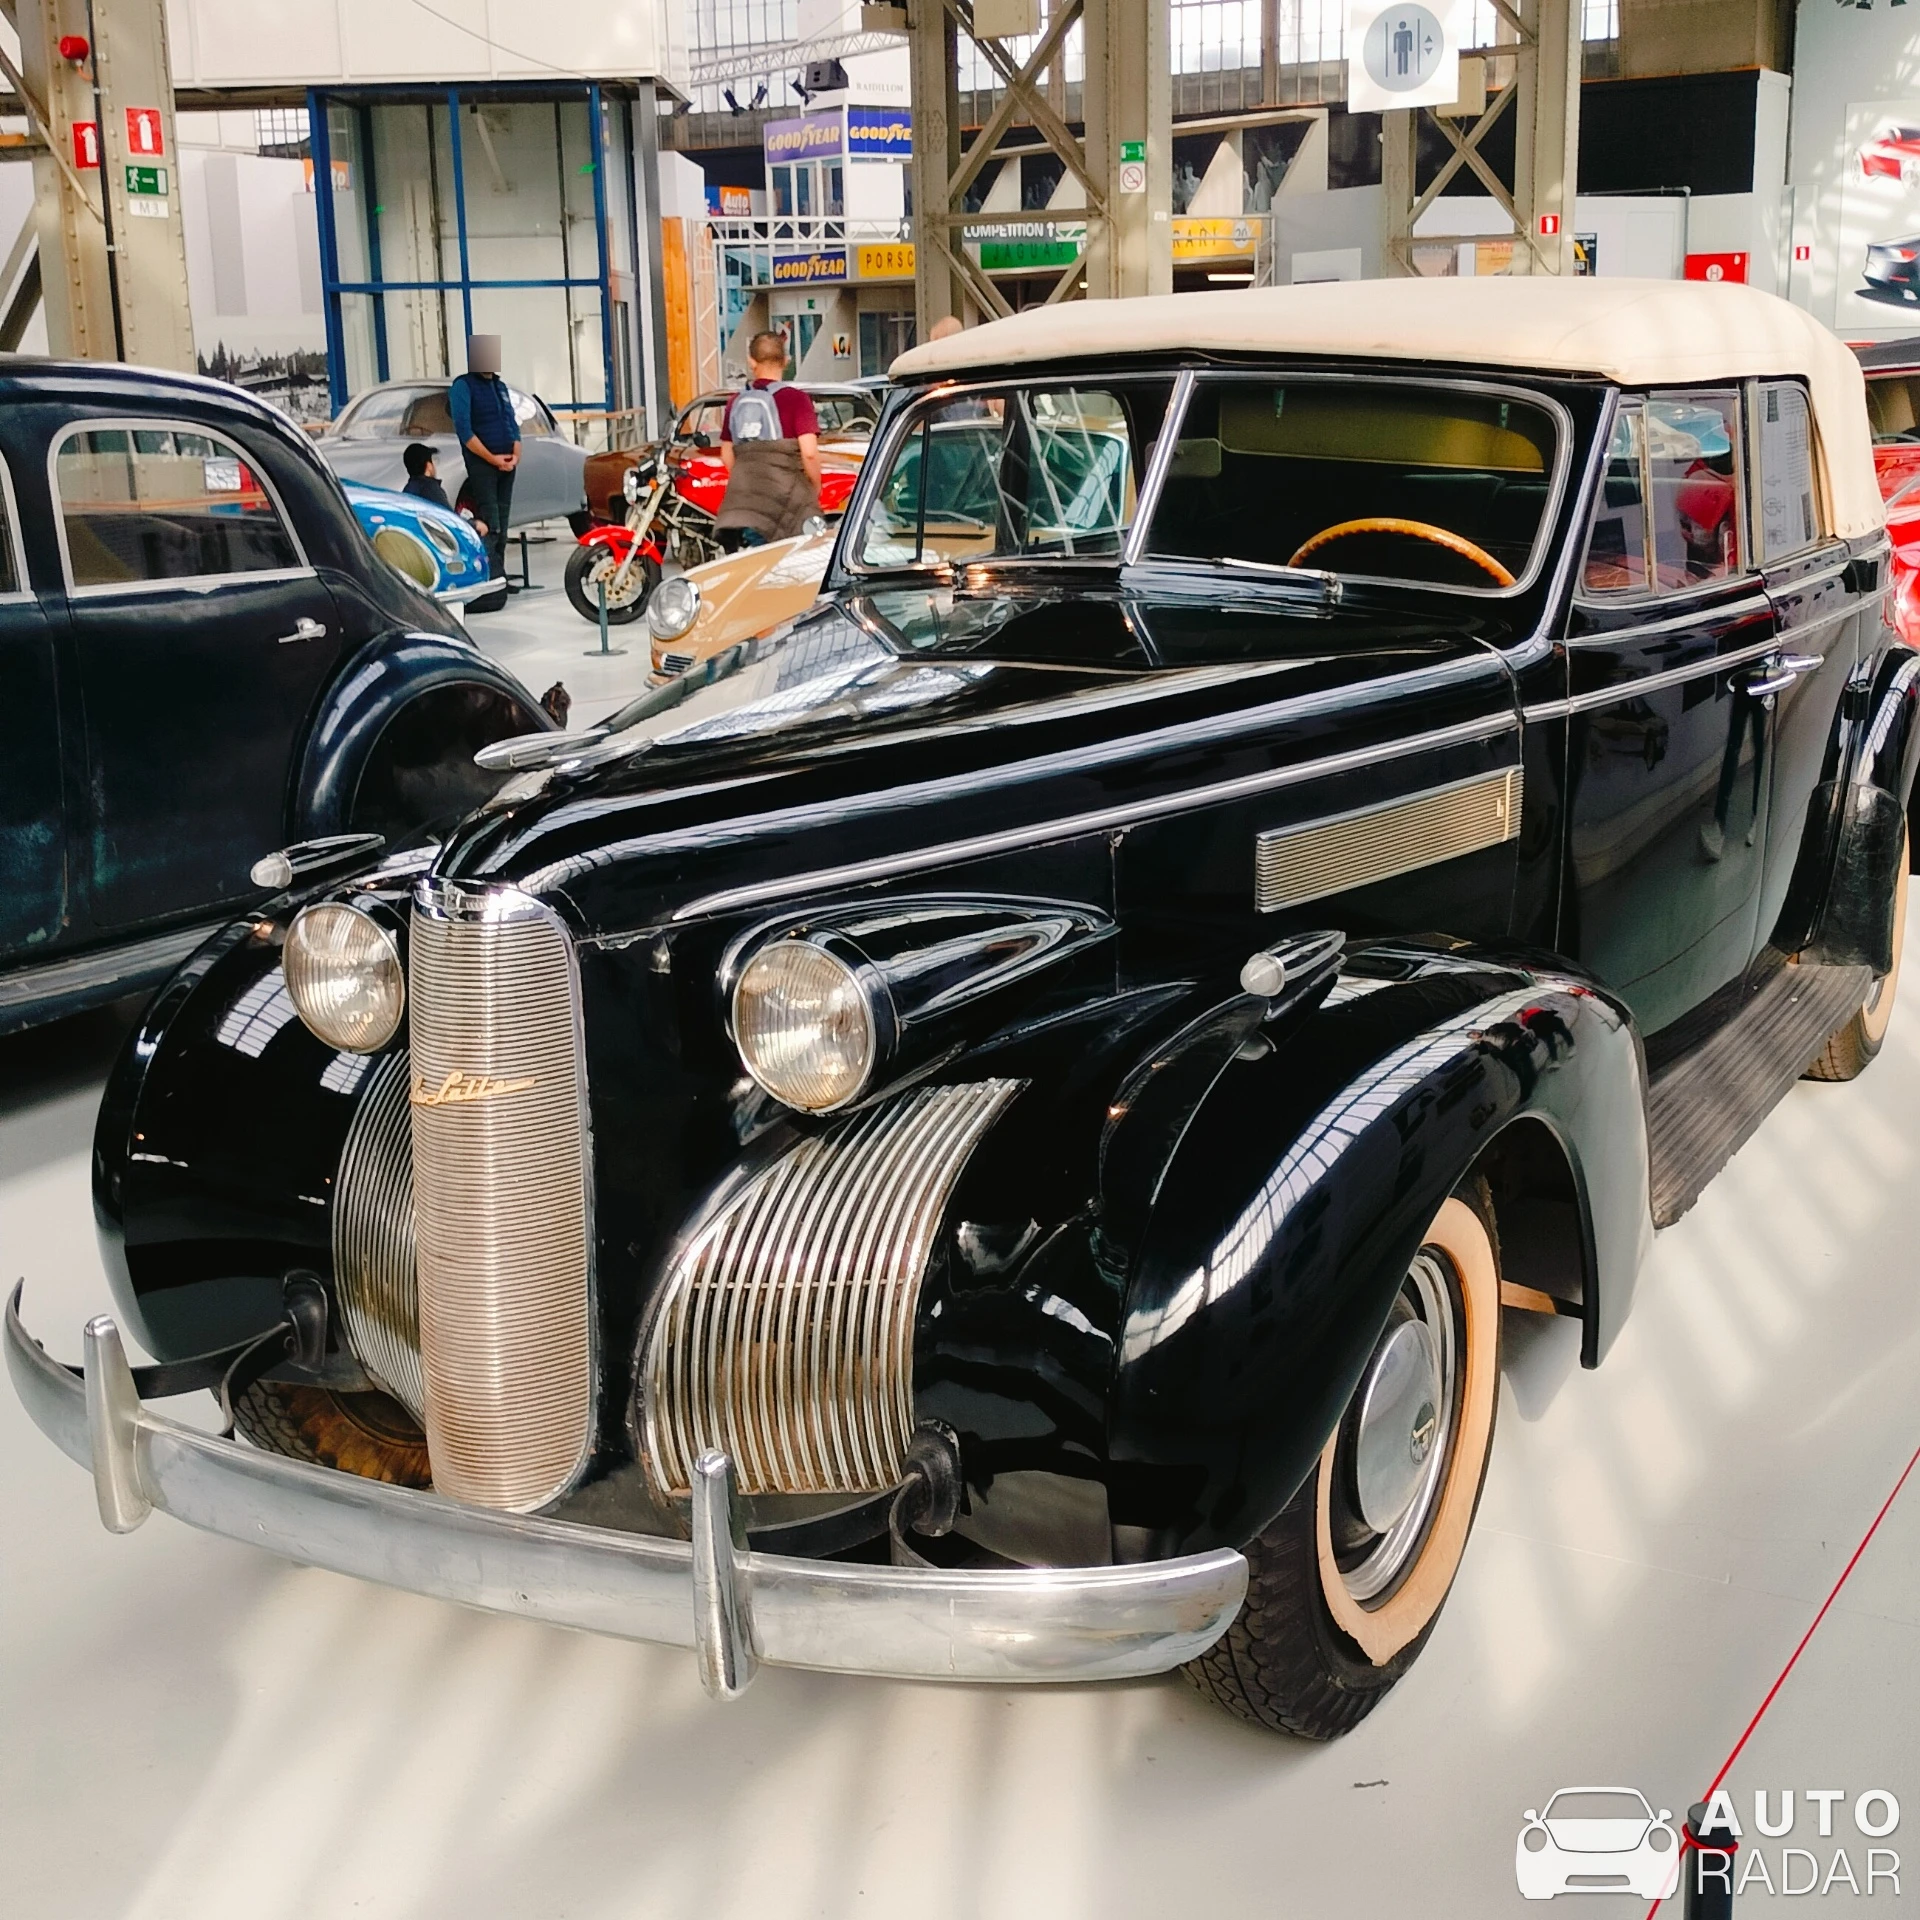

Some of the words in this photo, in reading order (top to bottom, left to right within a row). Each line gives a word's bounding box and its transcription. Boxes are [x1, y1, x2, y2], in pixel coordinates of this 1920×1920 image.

[767, 123, 840, 152] GOODYEAR
[963, 221, 1043, 238] COMPETITION
[993, 242, 1065, 261] JAGUAR
[774, 255, 845, 281] GOODYEAR
